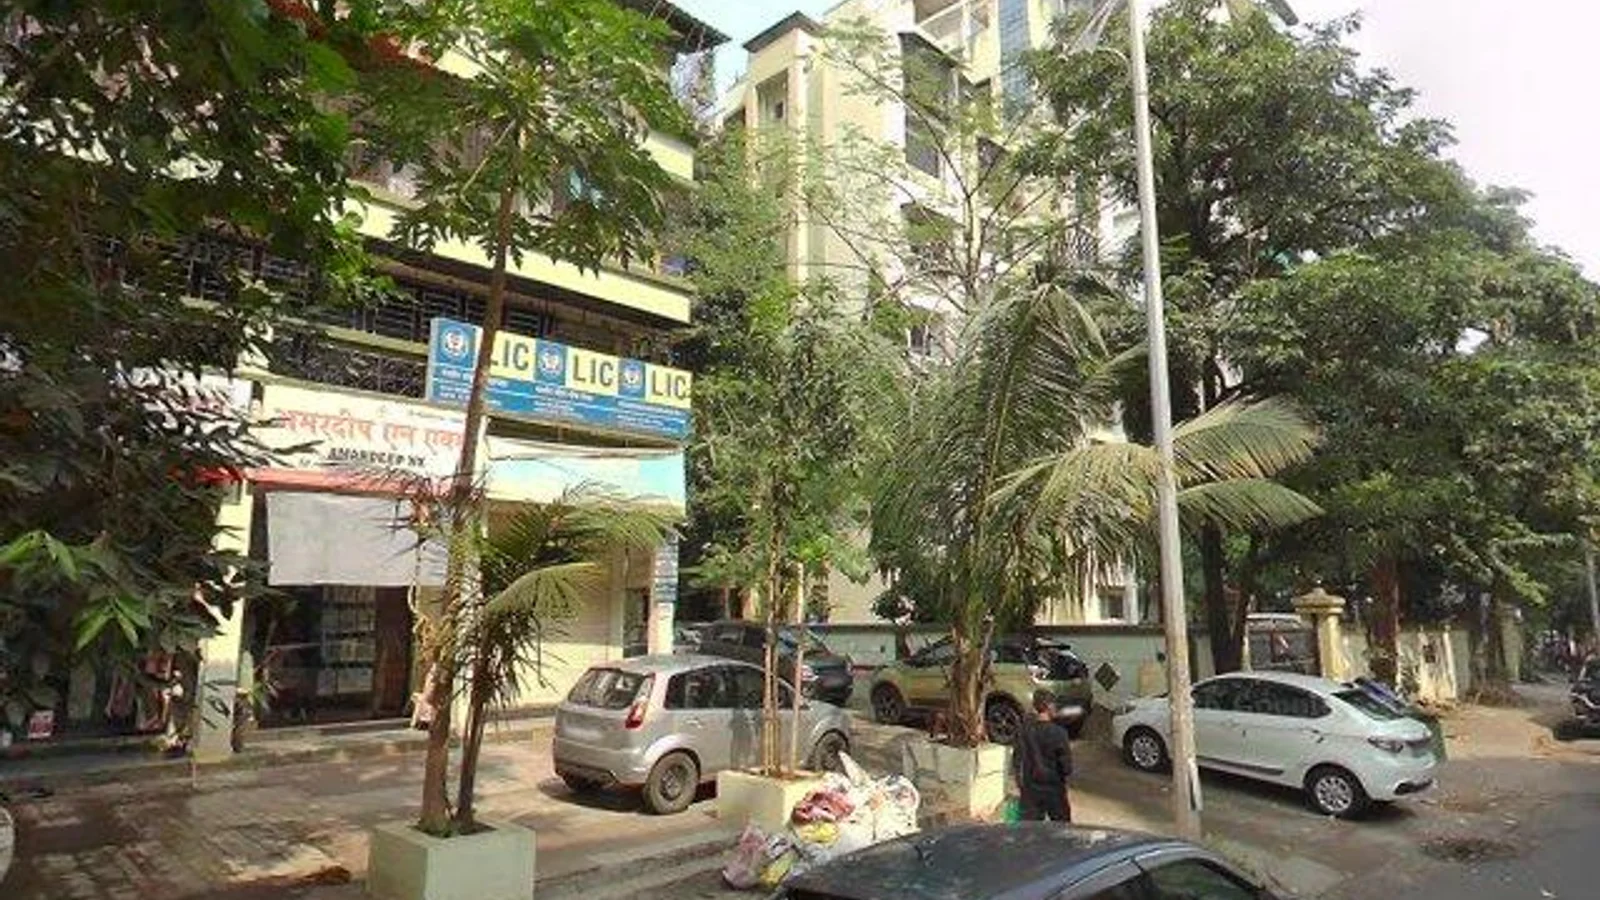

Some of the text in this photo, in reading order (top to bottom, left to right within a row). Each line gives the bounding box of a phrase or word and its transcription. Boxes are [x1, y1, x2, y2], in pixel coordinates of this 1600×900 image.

[491, 339, 530, 371] IC
[572, 354, 615, 388] LIC
[651, 368, 687, 401] LIC
